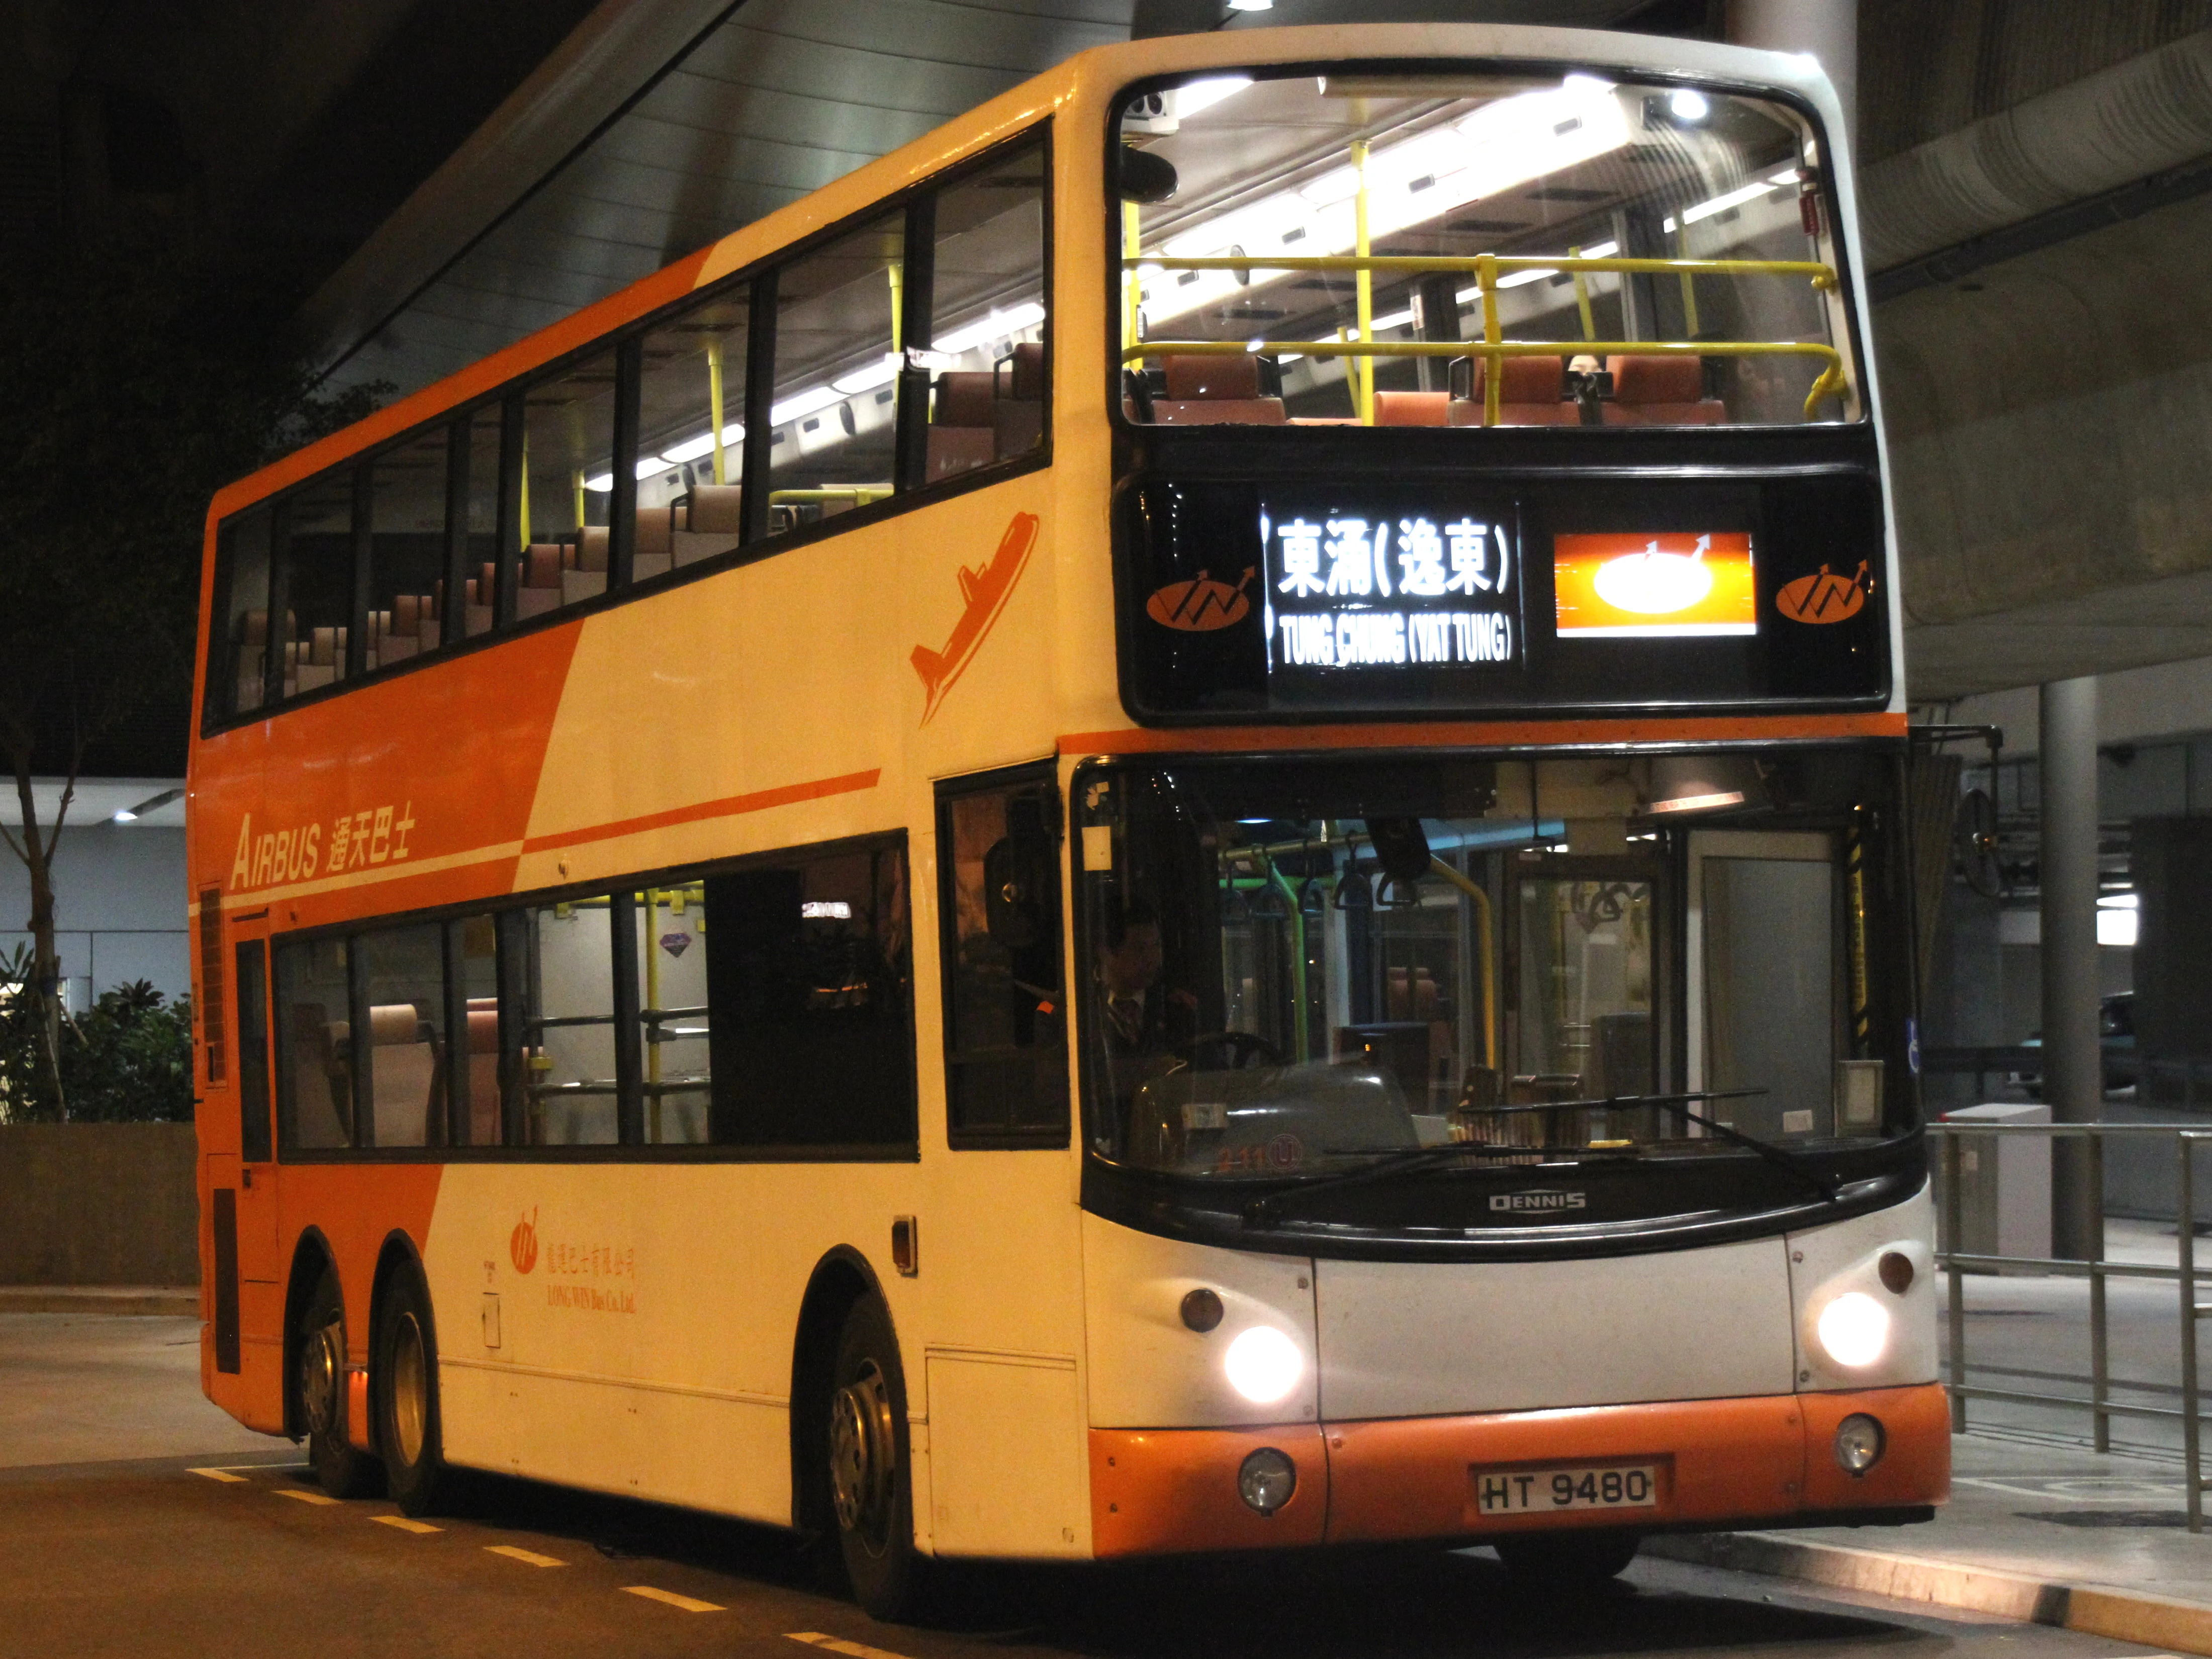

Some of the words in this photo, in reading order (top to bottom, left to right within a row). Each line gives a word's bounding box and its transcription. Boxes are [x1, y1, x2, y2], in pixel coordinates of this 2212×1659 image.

[1279, 614, 1334, 664] TUNG
[1336, 613, 1406, 665] CHUNG
[1489, 1192, 1586, 1212] DENNIS
[1486, 1476, 1533, 1509] HT
[1551, 1470, 1647, 1505] 9480
